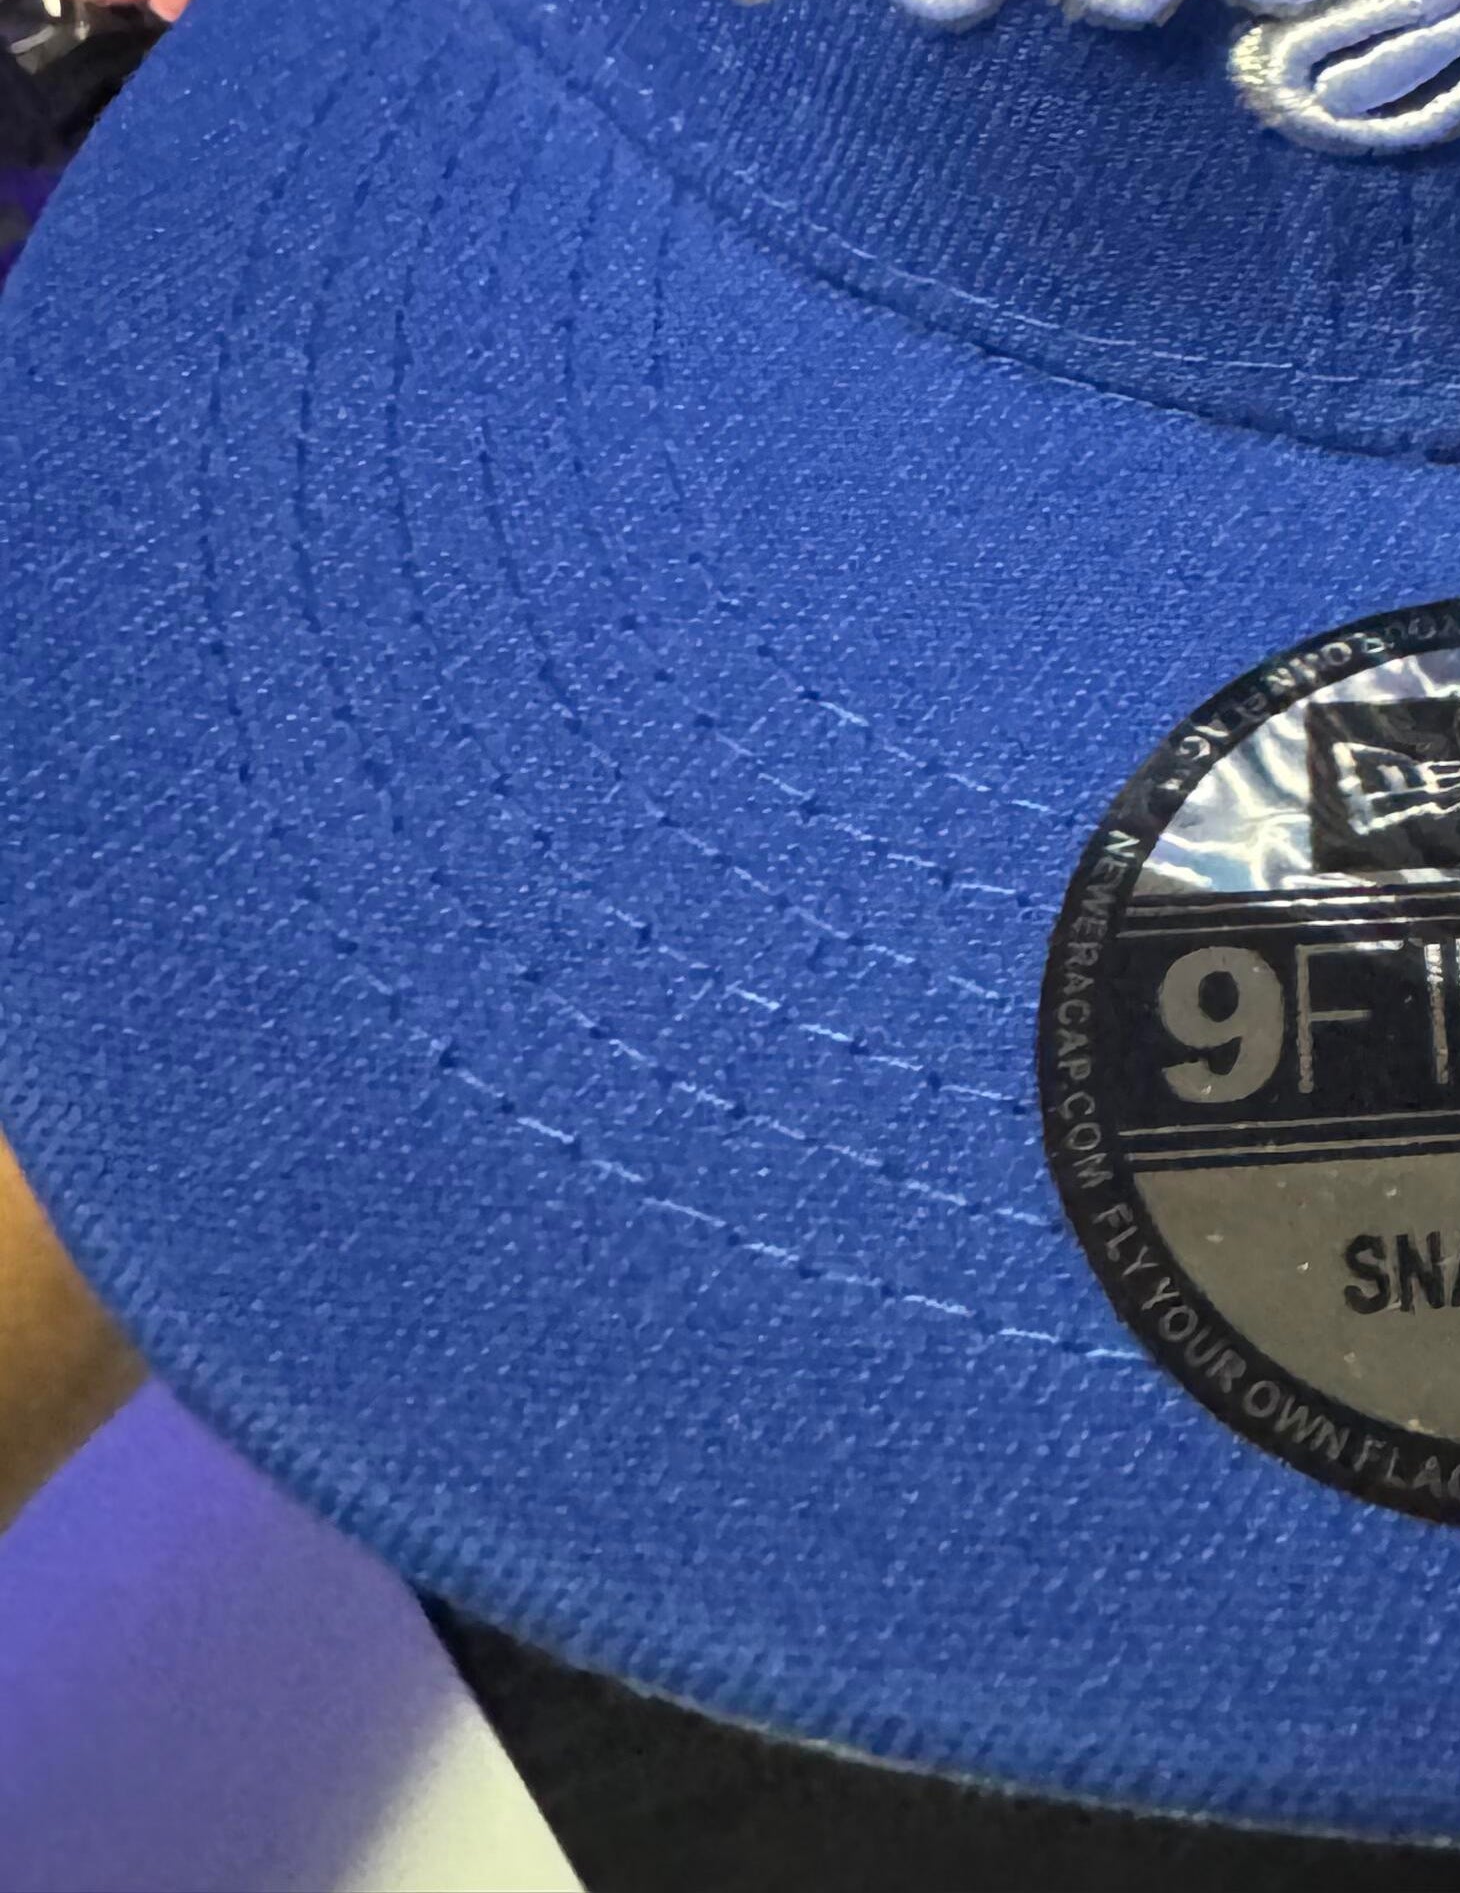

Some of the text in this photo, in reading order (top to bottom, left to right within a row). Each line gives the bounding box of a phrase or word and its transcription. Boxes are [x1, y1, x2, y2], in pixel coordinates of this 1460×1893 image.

[1056, 829, 1141, 1189] NEWERACAP.COM
[1093, 1202, 1159, 1277] FLY
[1141, 1276, 1248, 1394] YOUR
[1242, 1380, 1351, 1462] OWN
